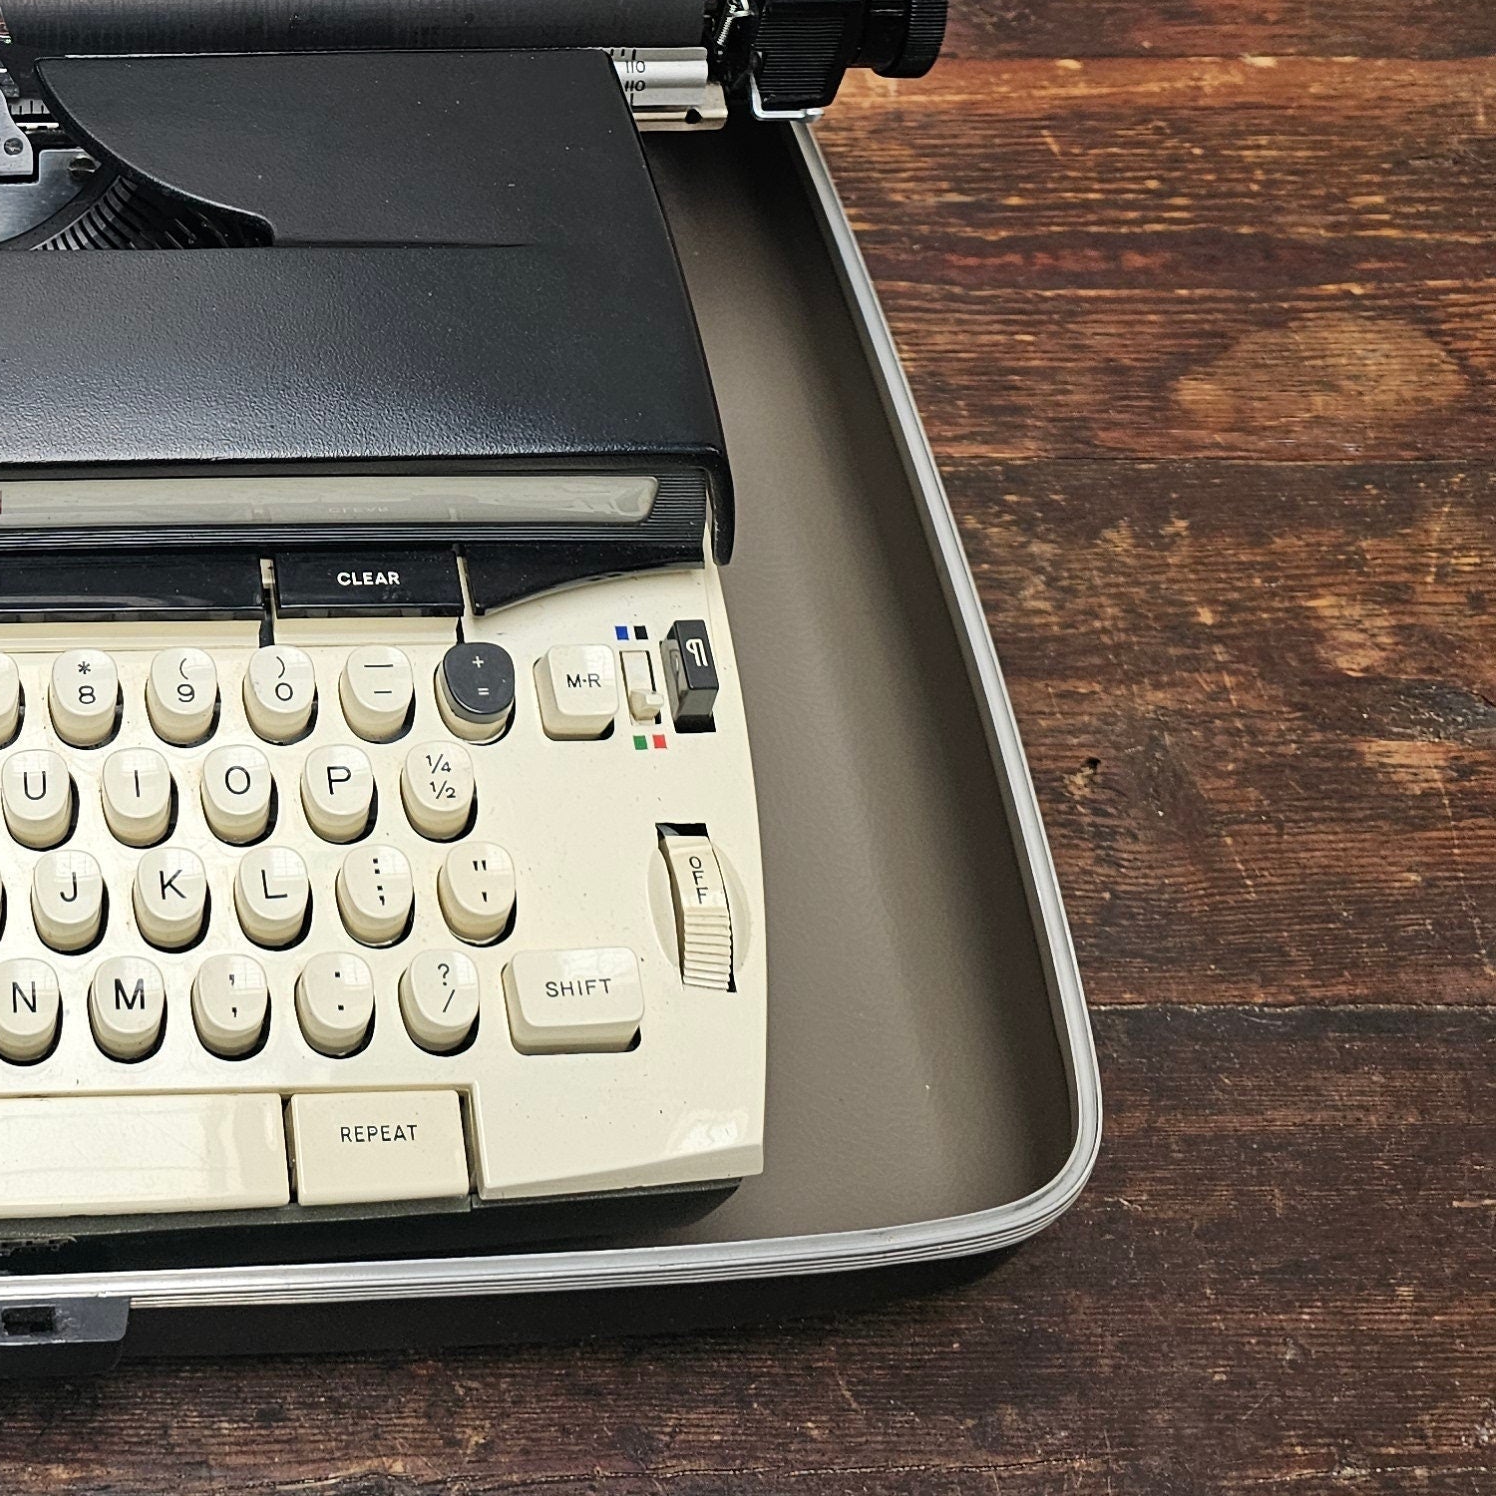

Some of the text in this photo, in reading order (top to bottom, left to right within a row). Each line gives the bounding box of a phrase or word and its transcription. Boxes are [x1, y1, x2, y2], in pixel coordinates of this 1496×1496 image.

[626, 61, 645, 73] 110
[625, 80, 646, 92] 110
[337, 571, 400, 586] CLEAR
[79, 685, 96, 703] 8
[178, 684, 195, 702] 9
[275, 682, 293, 702] 0
[24, 770, 48, 800] U
[225, 766, 252, 795] O
[327, 766, 351, 795] P
[60, 872, 78, 903] J
[159, 869, 186, 900] K
[260, 869, 288, 899] L
[688, 855, 709, 904] OFF
[437, 963, 450, 987] ?
[545, 978, 611, 997] SHIFT
[12, 982, 36, 1012] N
[114, 979, 146, 1009] M
[340, 1124, 418, 1144] REPEAT
